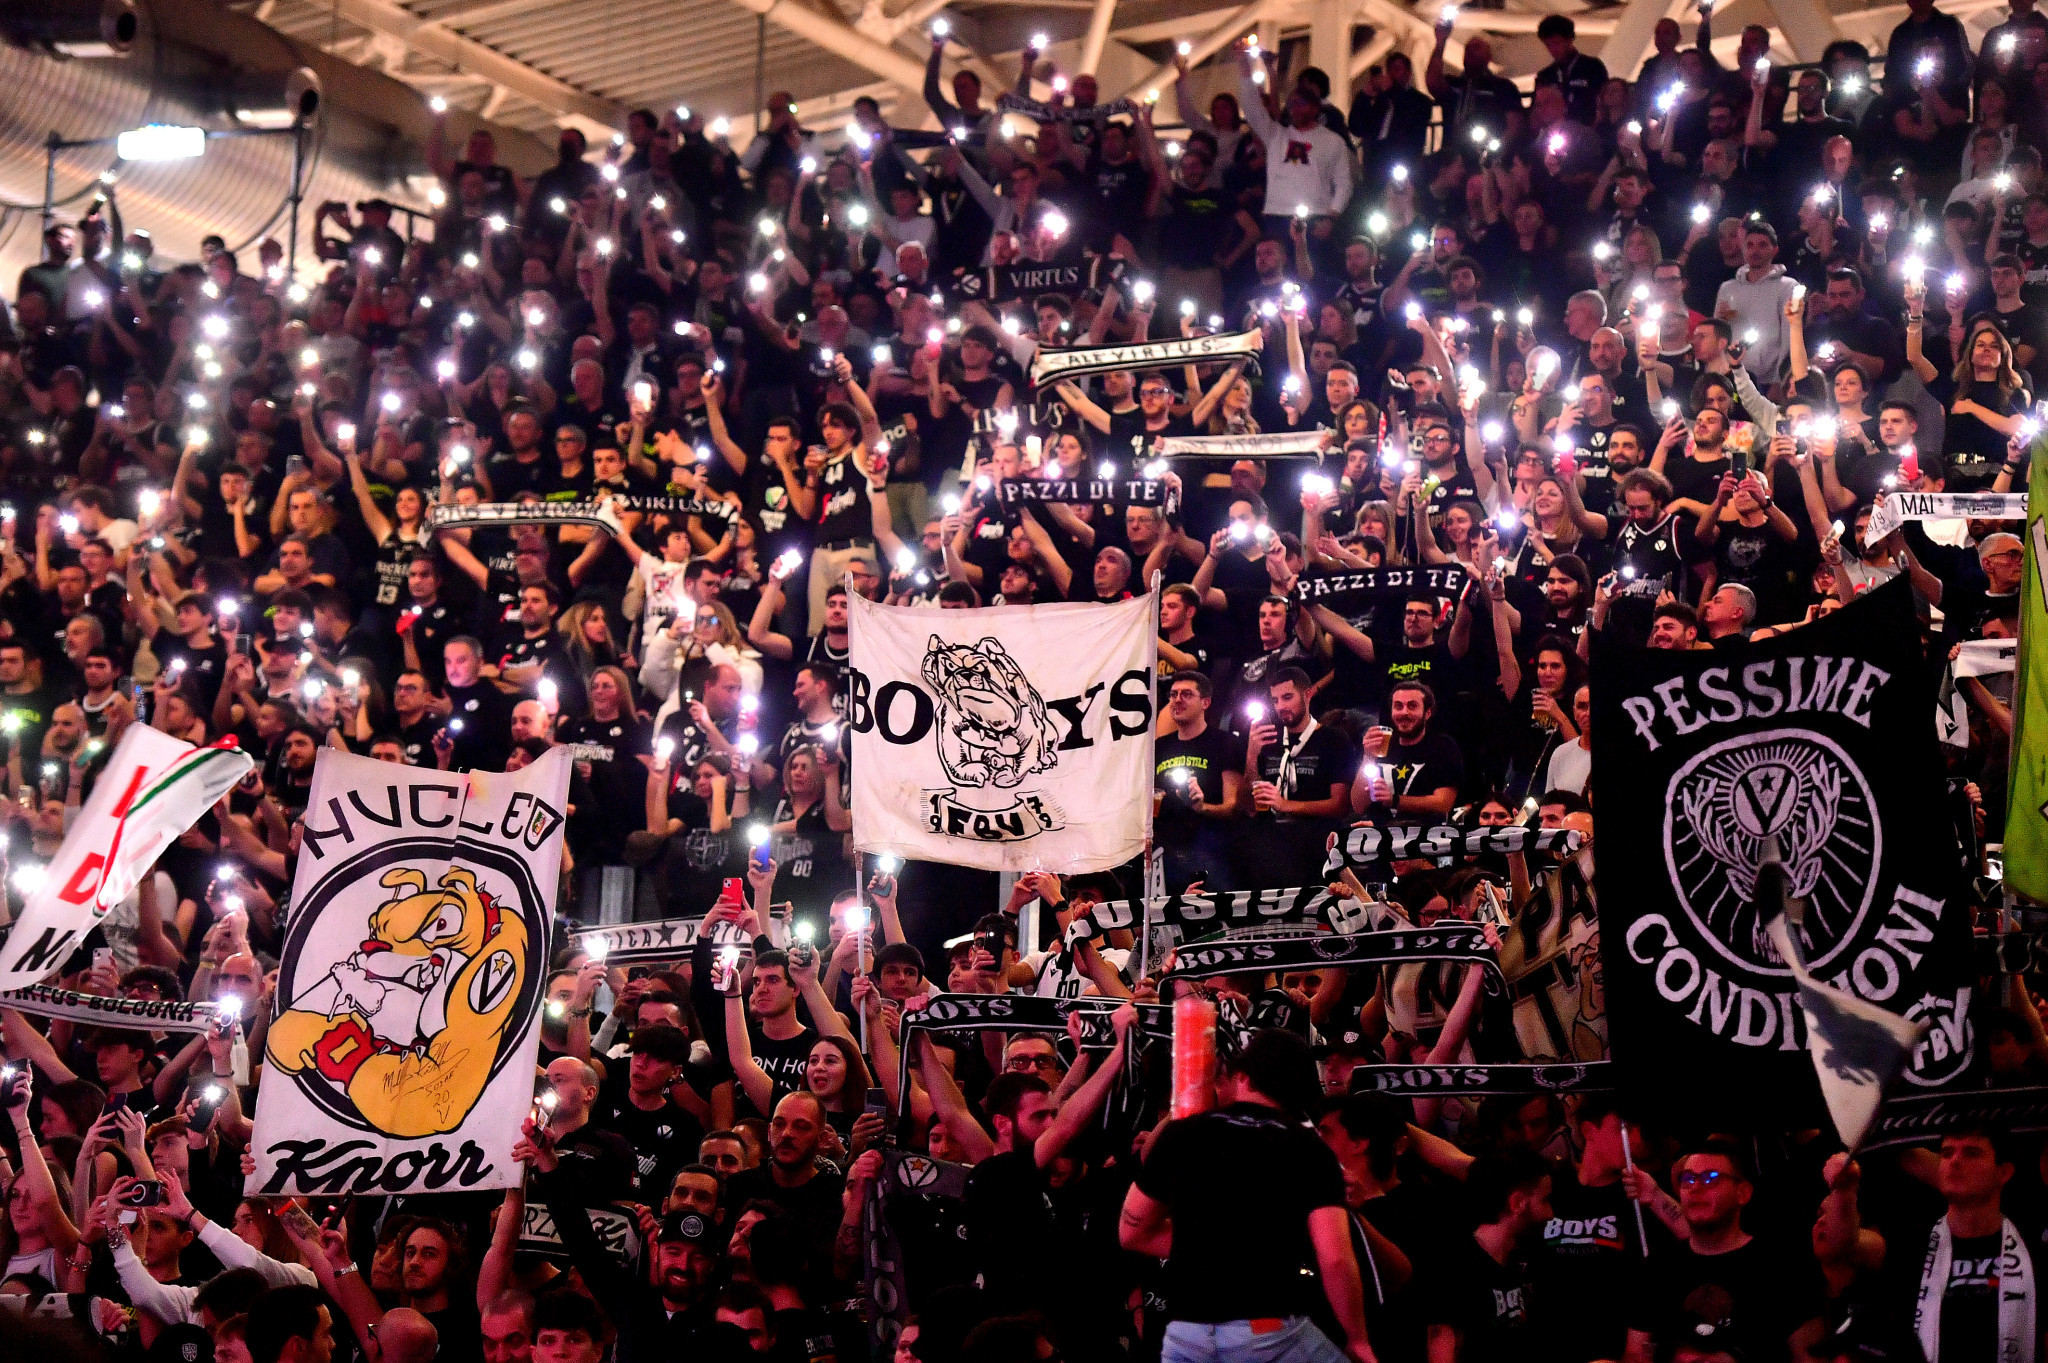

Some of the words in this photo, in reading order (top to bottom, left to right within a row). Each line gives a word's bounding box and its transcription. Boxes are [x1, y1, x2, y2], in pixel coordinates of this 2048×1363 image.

[1010, 266, 1079, 288] VIRTUS
[1117, 339, 1212, 362] VIRTUS
[1003, 481, 1078, 501] PAZZI
[1090, 480, 1113, 500] DI
[1126, 480, 1159, 500] TE
[1900, 494, 1936, 516] MAI
[1297, 572, 1375, 600] PAZZI
[1387, 570, 1414, 587] DI
[1427, 569, 1461, 591] TE
[1622, 655, 1891, 751] PESSIME
[1173, 944, 1276, 972] BOYS
[1626, 884, 1946, 1052] CONDIONI
[88, 996, 194, 1023] BOLOGNA
[1374, 1068, 1490, 1091] BOYS
[259, 1138, 494, 1195] Knorr
[1544, 1215, 1618, 1240] BOYS
